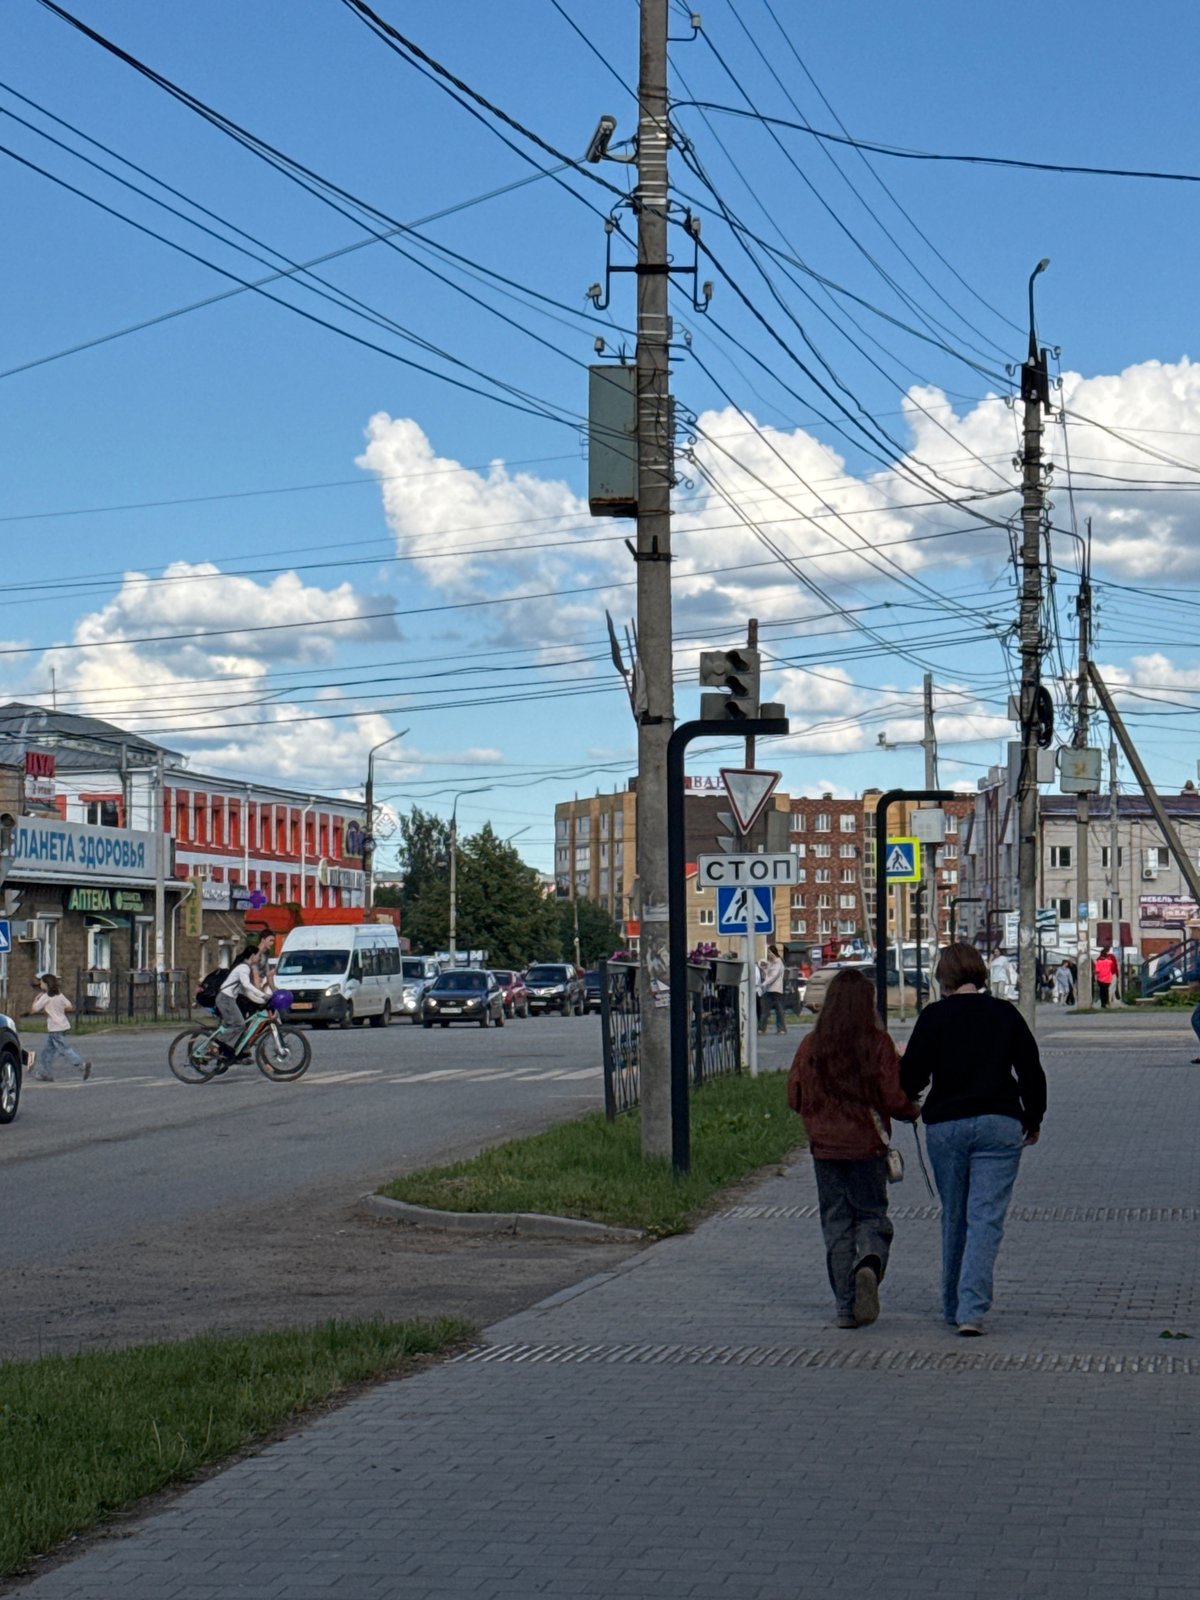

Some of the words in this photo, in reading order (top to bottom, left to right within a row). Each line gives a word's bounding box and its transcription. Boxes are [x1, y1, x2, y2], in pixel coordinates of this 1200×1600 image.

[79, 834, 145, 869] ЗДОРОВЬЯ
[706, 861, 790, 880] СТОП
[68, 888, 112, 911] АПТЕКА
